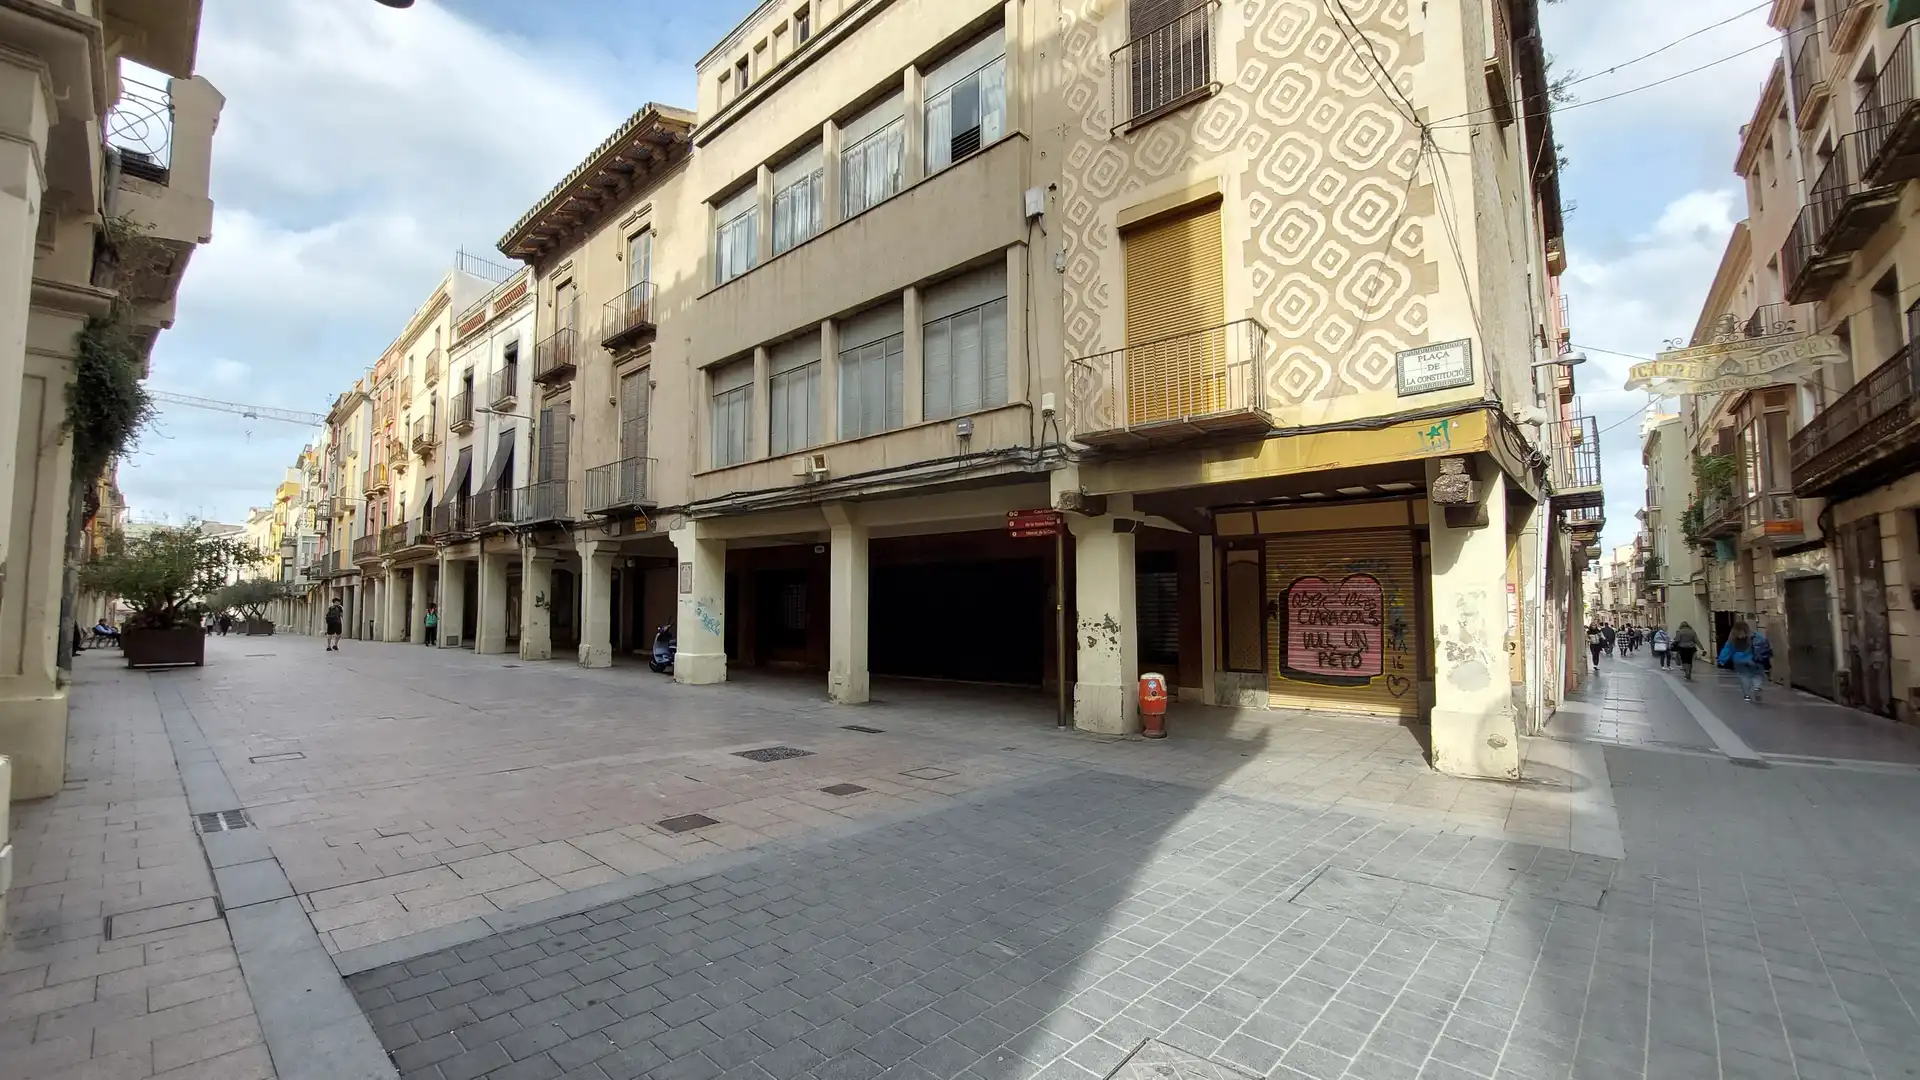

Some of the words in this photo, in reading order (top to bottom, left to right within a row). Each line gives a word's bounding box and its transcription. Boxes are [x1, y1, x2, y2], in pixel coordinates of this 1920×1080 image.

[1417, 351, 1450, 362] PLAÇA
[1745, 339, 1834, 373] FERRERS
[1427, 363, 1441, 371] DE
[1406, 378, 1416, 386] LA
[1417, 368, 1464, 384] CONSTITUCIÓ
